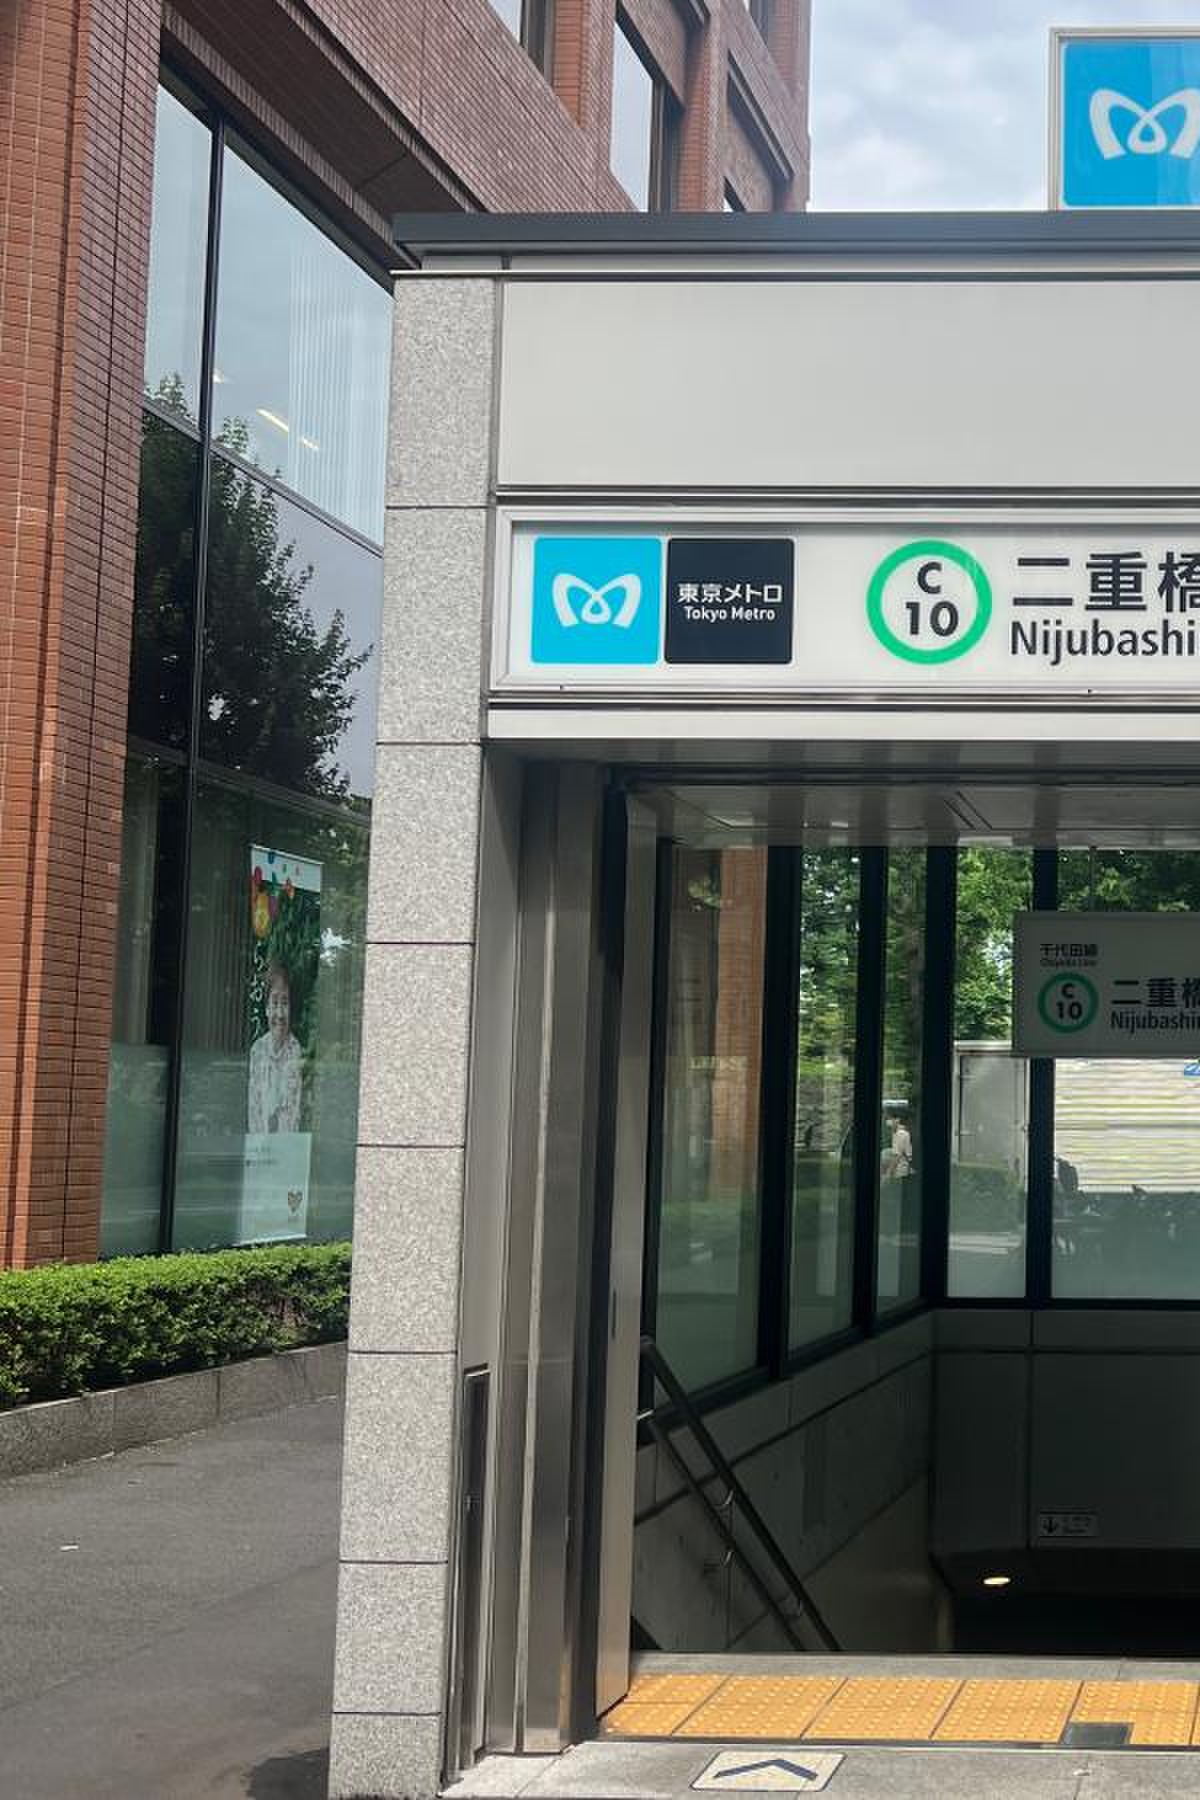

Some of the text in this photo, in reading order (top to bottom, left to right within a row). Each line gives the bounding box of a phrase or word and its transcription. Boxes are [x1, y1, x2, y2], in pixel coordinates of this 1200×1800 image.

[916, 561, 942, 595] C
[677, 582, 783, 604] 東京メトロ
[684, 605, 776, 622] Tokyo Metro
[905, 601, 959, 636] 10
[1061, 982, 1075, 999] C
[1056, 1001, 1083, 1020] 10
